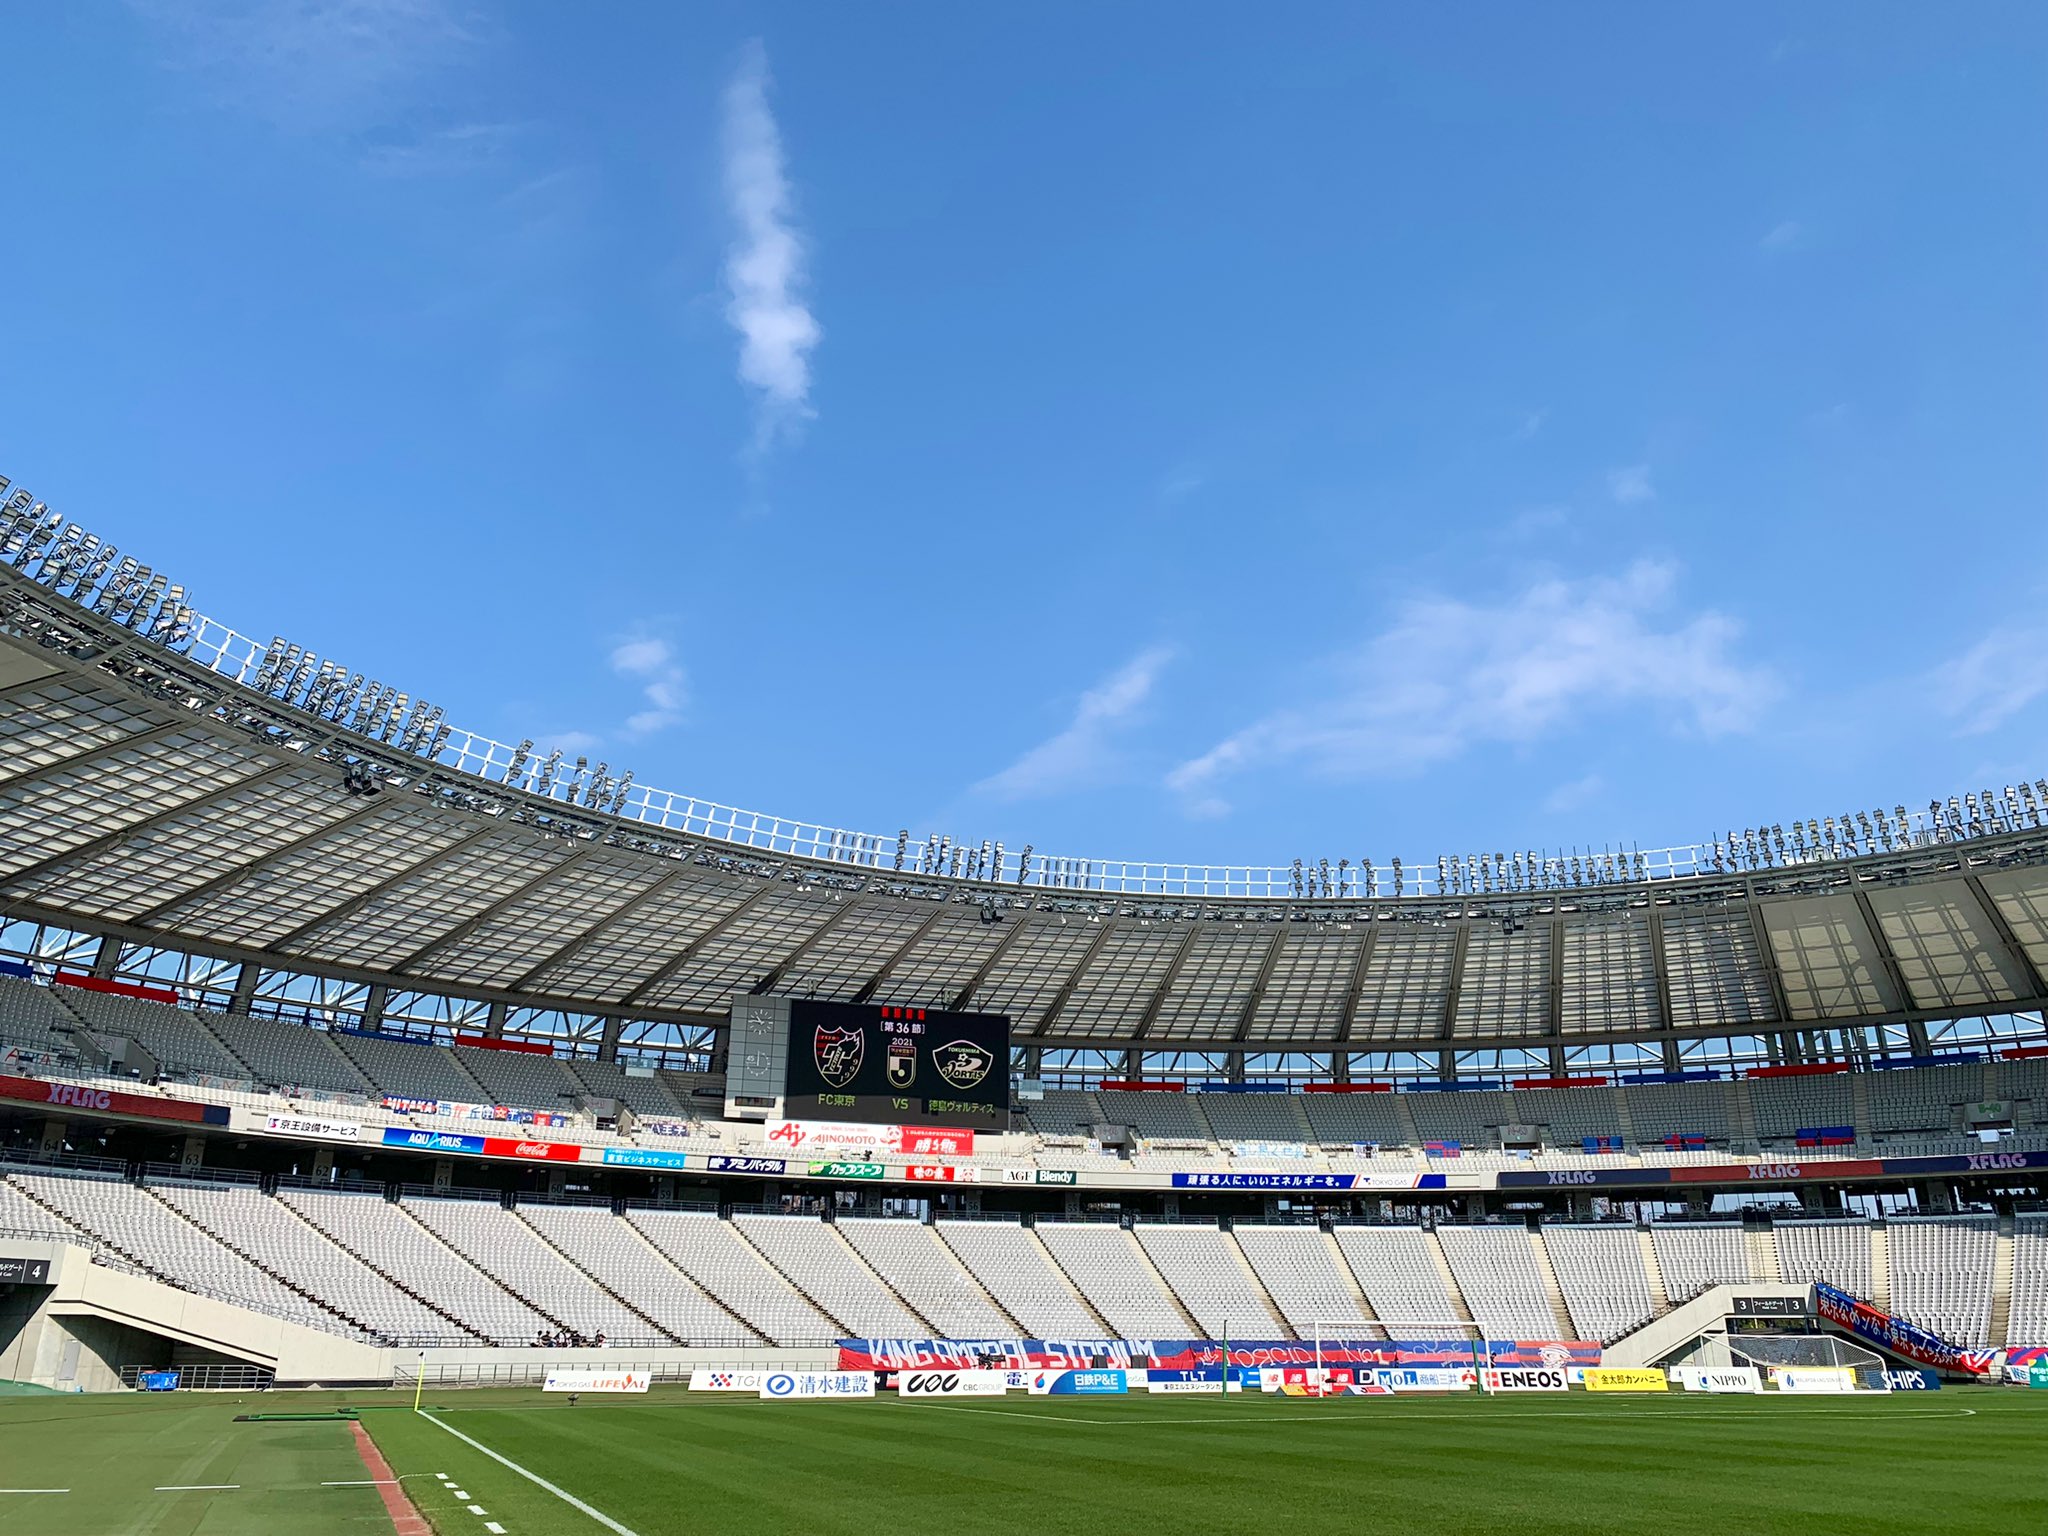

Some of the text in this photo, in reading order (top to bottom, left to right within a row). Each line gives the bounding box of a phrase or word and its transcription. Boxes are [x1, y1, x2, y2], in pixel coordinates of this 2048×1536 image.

[892, 1037, 913, 1046] 2021
[947, 1046, 980, 1054] TOKUSHIMA
[818, 1093, 856, 1106] FC東京
[892, 1098, 909, 1110] VS
[928, 1099, 995, 1114] 徳島ヴォルティス
[279, 1119, 358, 1137] 京王設備サービス
[407, 1131, 463, 1149] AQUARIUS
[810, 1134, 876, 1145] AJINOMOTO
[185, 1153, 199, 1166] 63
[607, 1153, 681, 1167] 東京ビジネスサービス
[727, 1158, 783, 1172] アミノバイタル
[315, 1165, 329, 1177] 62
[829, 1164, 883, 1176] カップスープ
[913, 1167, 944, 1179] 味の素
[1007, 1171, 1033, 1181] AGF
[437, 1175, 449, 1186] 61
[1039, 1171, 1073, 1184] Blendy
[1187, 1174, 1340, 1187] 頑張る人に、いいエネルギーを。
[551, 1183, 563, 1194] 60
[31, 1264, 41, 1278] 4
[1739, 1300, 1747, 1310] 3
[1792, 1300, 1800, 1310] 3
[868, 1339, 937, 1369] KING
[1043, 1339, 1163, 1369] STADIUM
[1074, 1374, 1118, 1386] 日鉄P&E
[1180, 1371, 1206, 1381] TLT
[1378, 1371, 1418, 1385] MOL
[1419, 1374, 1458, 1385] 商船三井
[1500, 1371, 1562, 1388] ENEOS
[1601, 1374, 1663, 1385] 金太郎カンパニー
[1711, 1375, 1747, 1386] NIPPO
[592, 1375, 647, 1390] LIFEVAL
[799, 1375, 869, 1394] 清水建設
[963, 1383, 979, 1391] CBC
